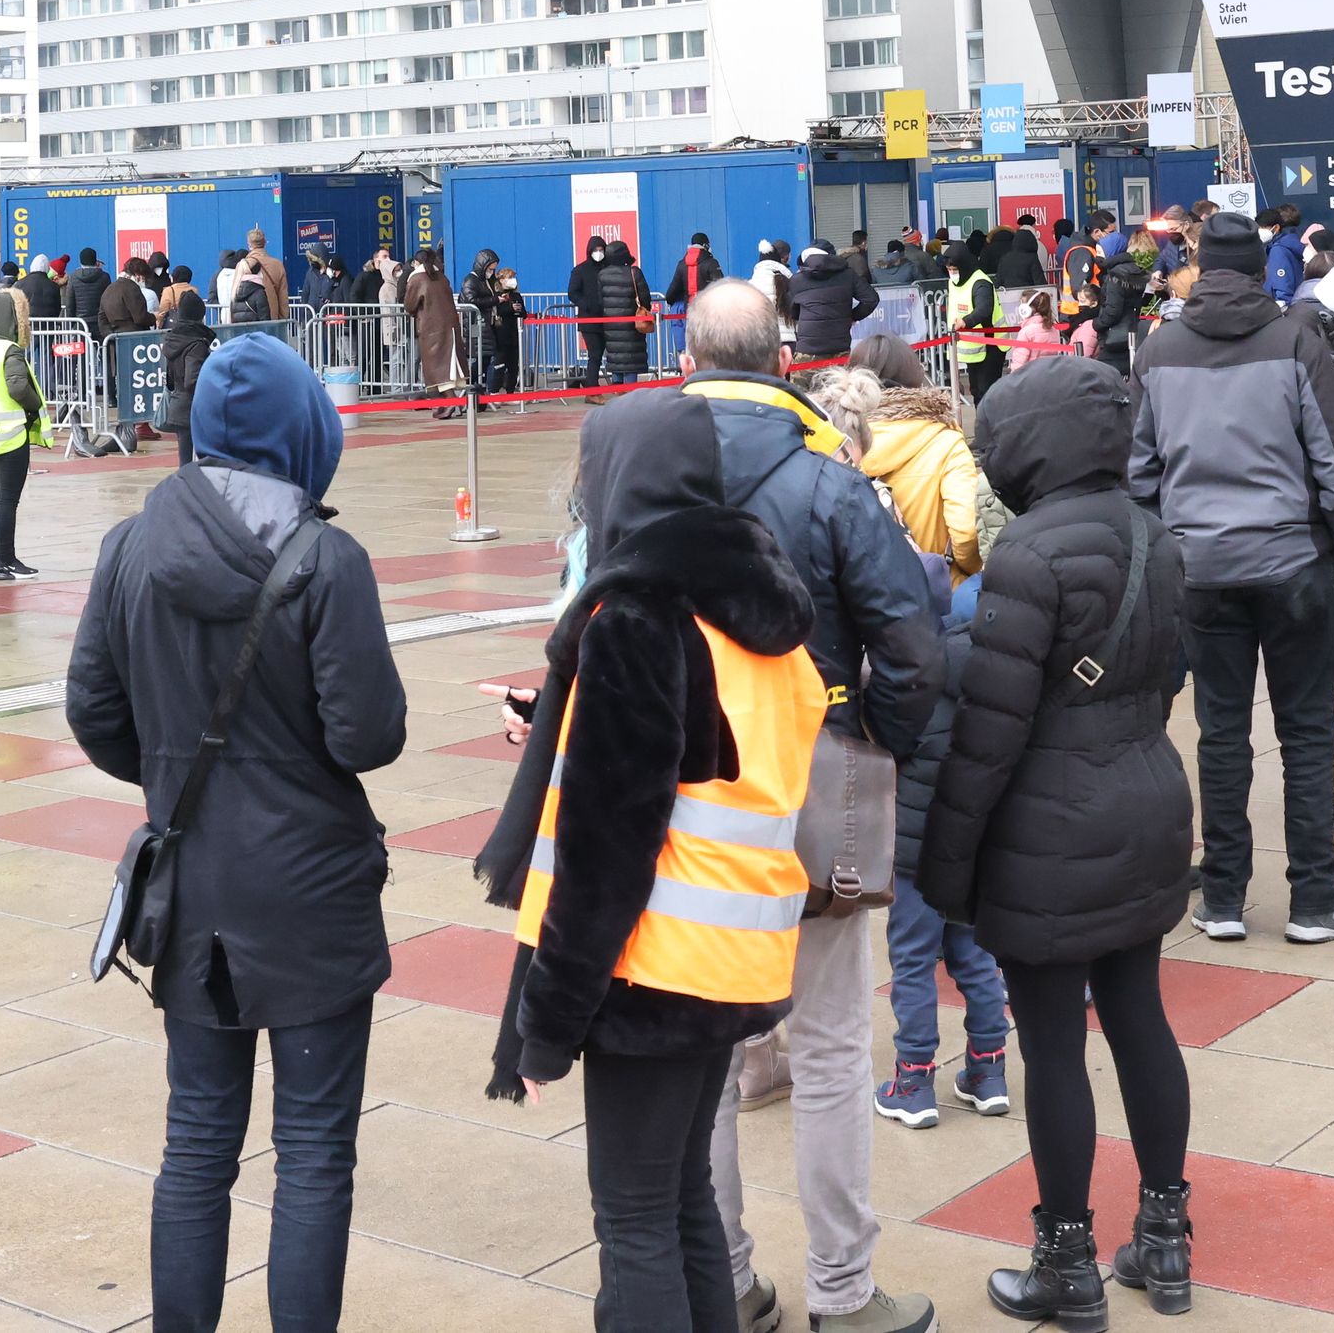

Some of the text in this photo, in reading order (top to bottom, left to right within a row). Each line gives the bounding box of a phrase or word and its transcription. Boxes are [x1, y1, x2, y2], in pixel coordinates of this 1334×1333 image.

[1219, 2, 1247, 14] Stadt
[1219, 14, 1248, 25] Wien
[986, 107, 1019, 120] ANTI-
[1151, 102, 1192, 113] IMPFEN
[893, 119, 918, 131] PCR
[990, 122, 1016, 134] GEN
[999, 172, 1060, 181] SAMARITERBUND
[47, 182, 216, 197] www.containex.com
[418, 204, 432, 248] CON
[132, 343, 163, 364] CO
[133, 394, 146, 414] &
